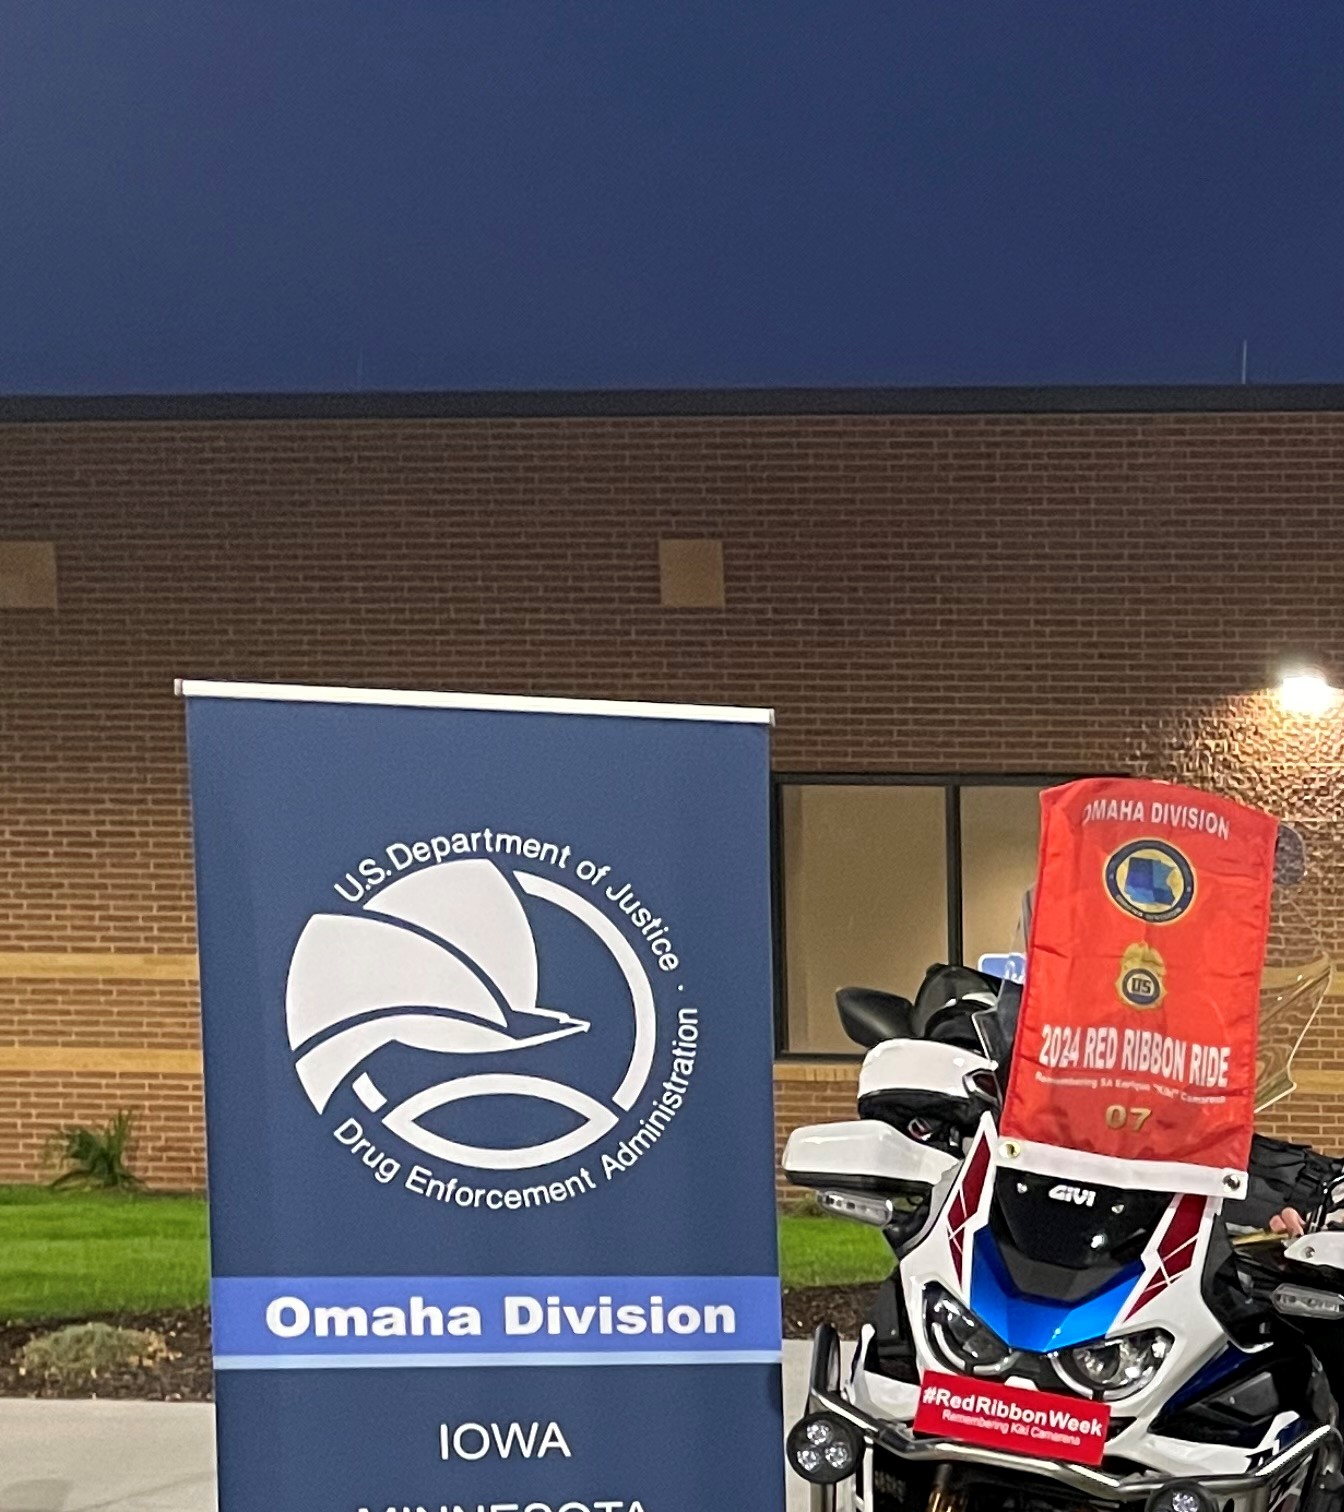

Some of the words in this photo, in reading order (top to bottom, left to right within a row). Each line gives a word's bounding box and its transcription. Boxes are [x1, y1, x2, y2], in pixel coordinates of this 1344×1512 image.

[1151, 801, 1230, 840] DIVISION
[386, 828, 571, 870] Department
[576, 859, 611, 886] of
[605, 884, 680, 971] Justice
[1131, 977, 1152, 994] US
[1038, 1024, 1082, 1068] 2024
[1083, 1026, 1118, 1069] RED
[1121, 1028, 1187, 1082] RIBBON
[1189, 1043, 1231, 1088] RIDE
[333, 1117, 400, 1184] Drug
[405, 1164, 597, 1210] Enforcement
[600, 1007, 699, 1179] Administration
[1105, 1104, 1152, 1132] 07
[265, 1296, 482, 1338] Omaha
[504, 1296, 736, 1336] Division
[922, 1386, 1103, 1437] #RedRibbonWeek
[440, 1421, 572, 1460] IOWA
